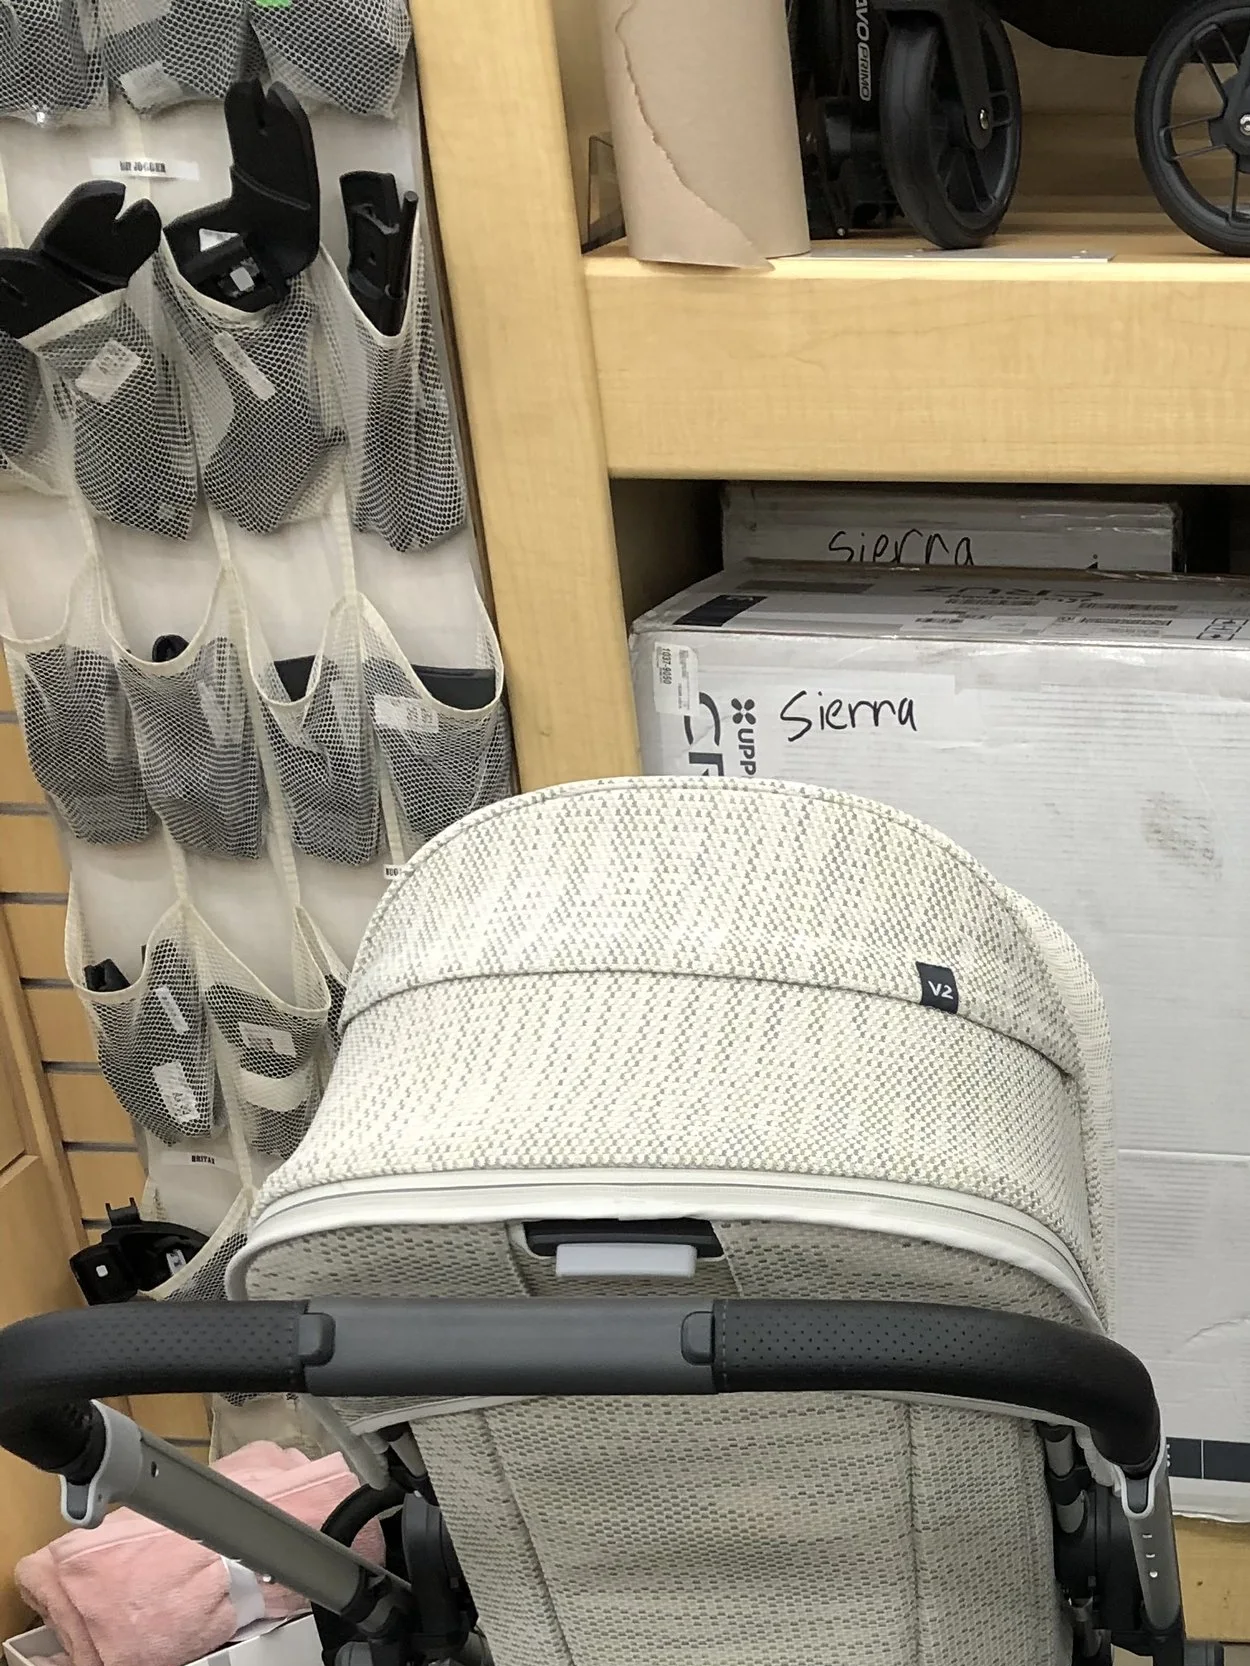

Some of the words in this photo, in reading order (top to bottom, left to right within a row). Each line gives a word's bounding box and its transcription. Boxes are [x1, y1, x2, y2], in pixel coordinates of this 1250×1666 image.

[859, 44, 871, 100] PRIMO
[780, 690, 917, 742] Sierra
[928, 980, 954, 1000] V2
[191, 1155, 215, 1164] BRITAX
